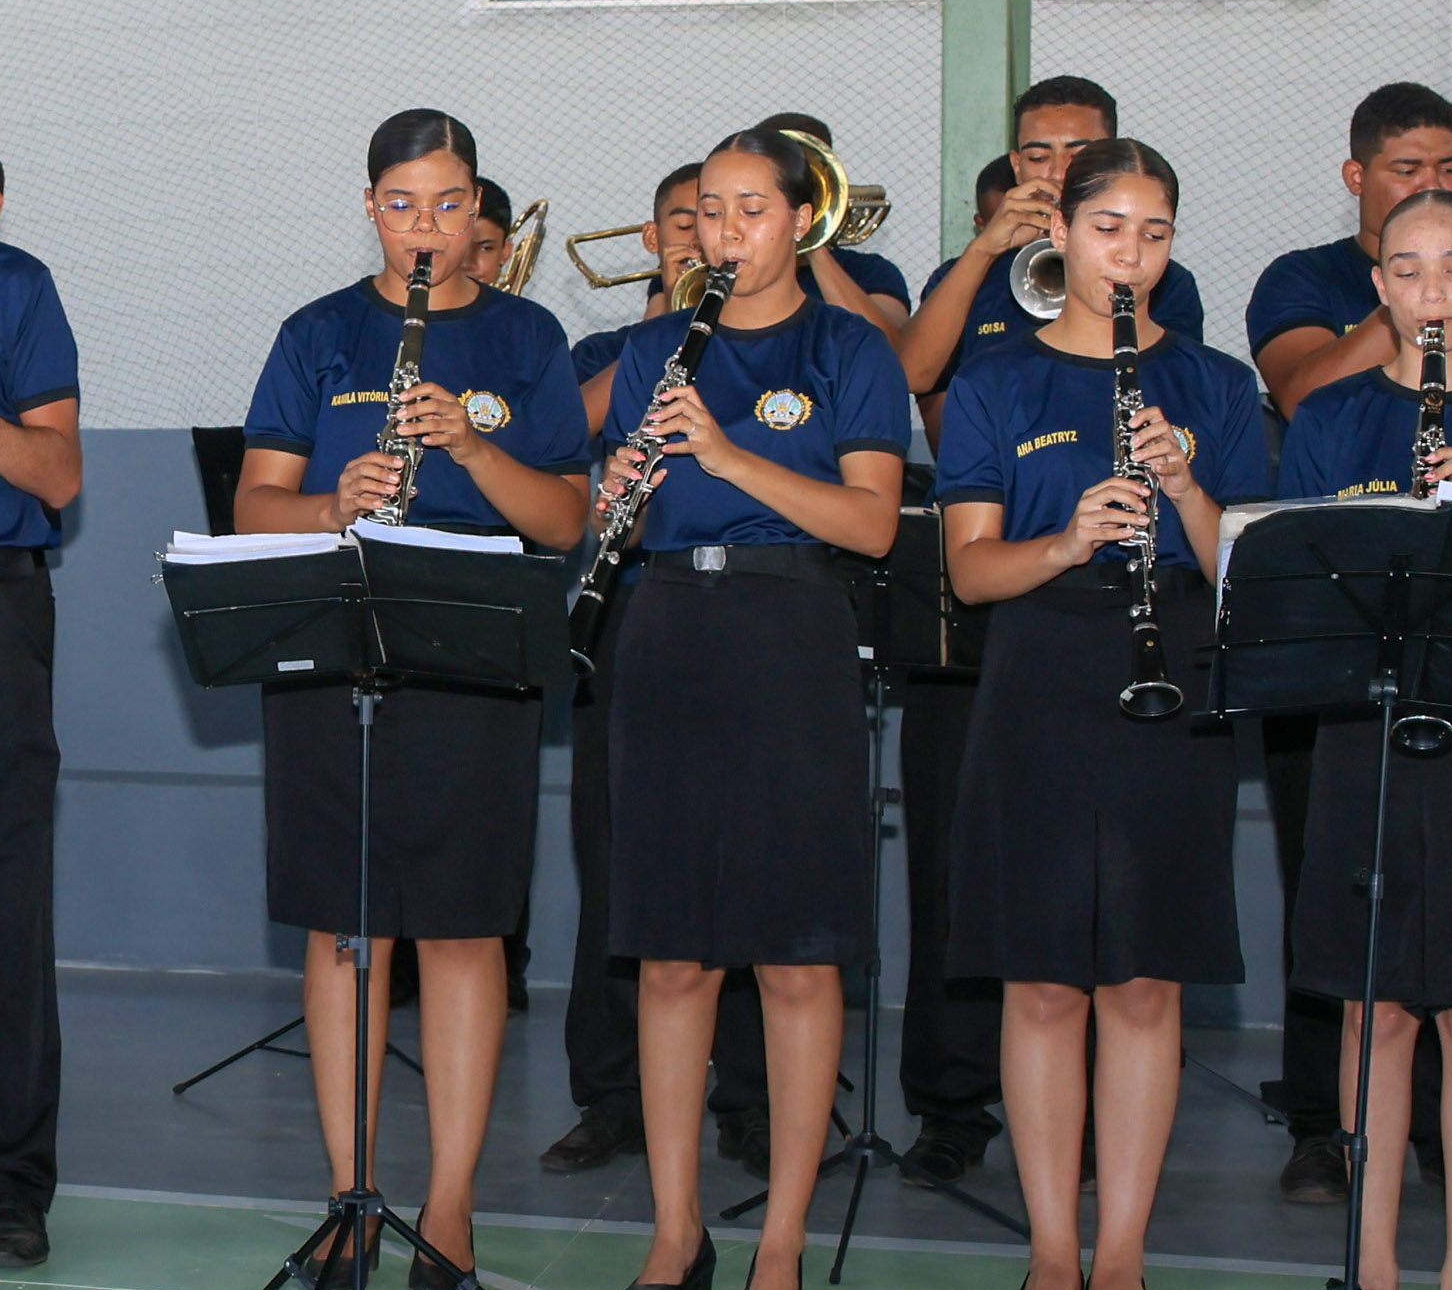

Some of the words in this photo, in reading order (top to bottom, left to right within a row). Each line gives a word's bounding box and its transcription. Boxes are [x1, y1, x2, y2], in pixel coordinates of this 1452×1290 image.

[357, 389, 390, 403] VITÓRIA
[1016, 443, 1034, 458] ANA
[1035, 430, 1078, 450] BEATRYZ
[1337, 483, 1364, 500] MARIA
[1365, 477, 1397, 493] JÚLIA
